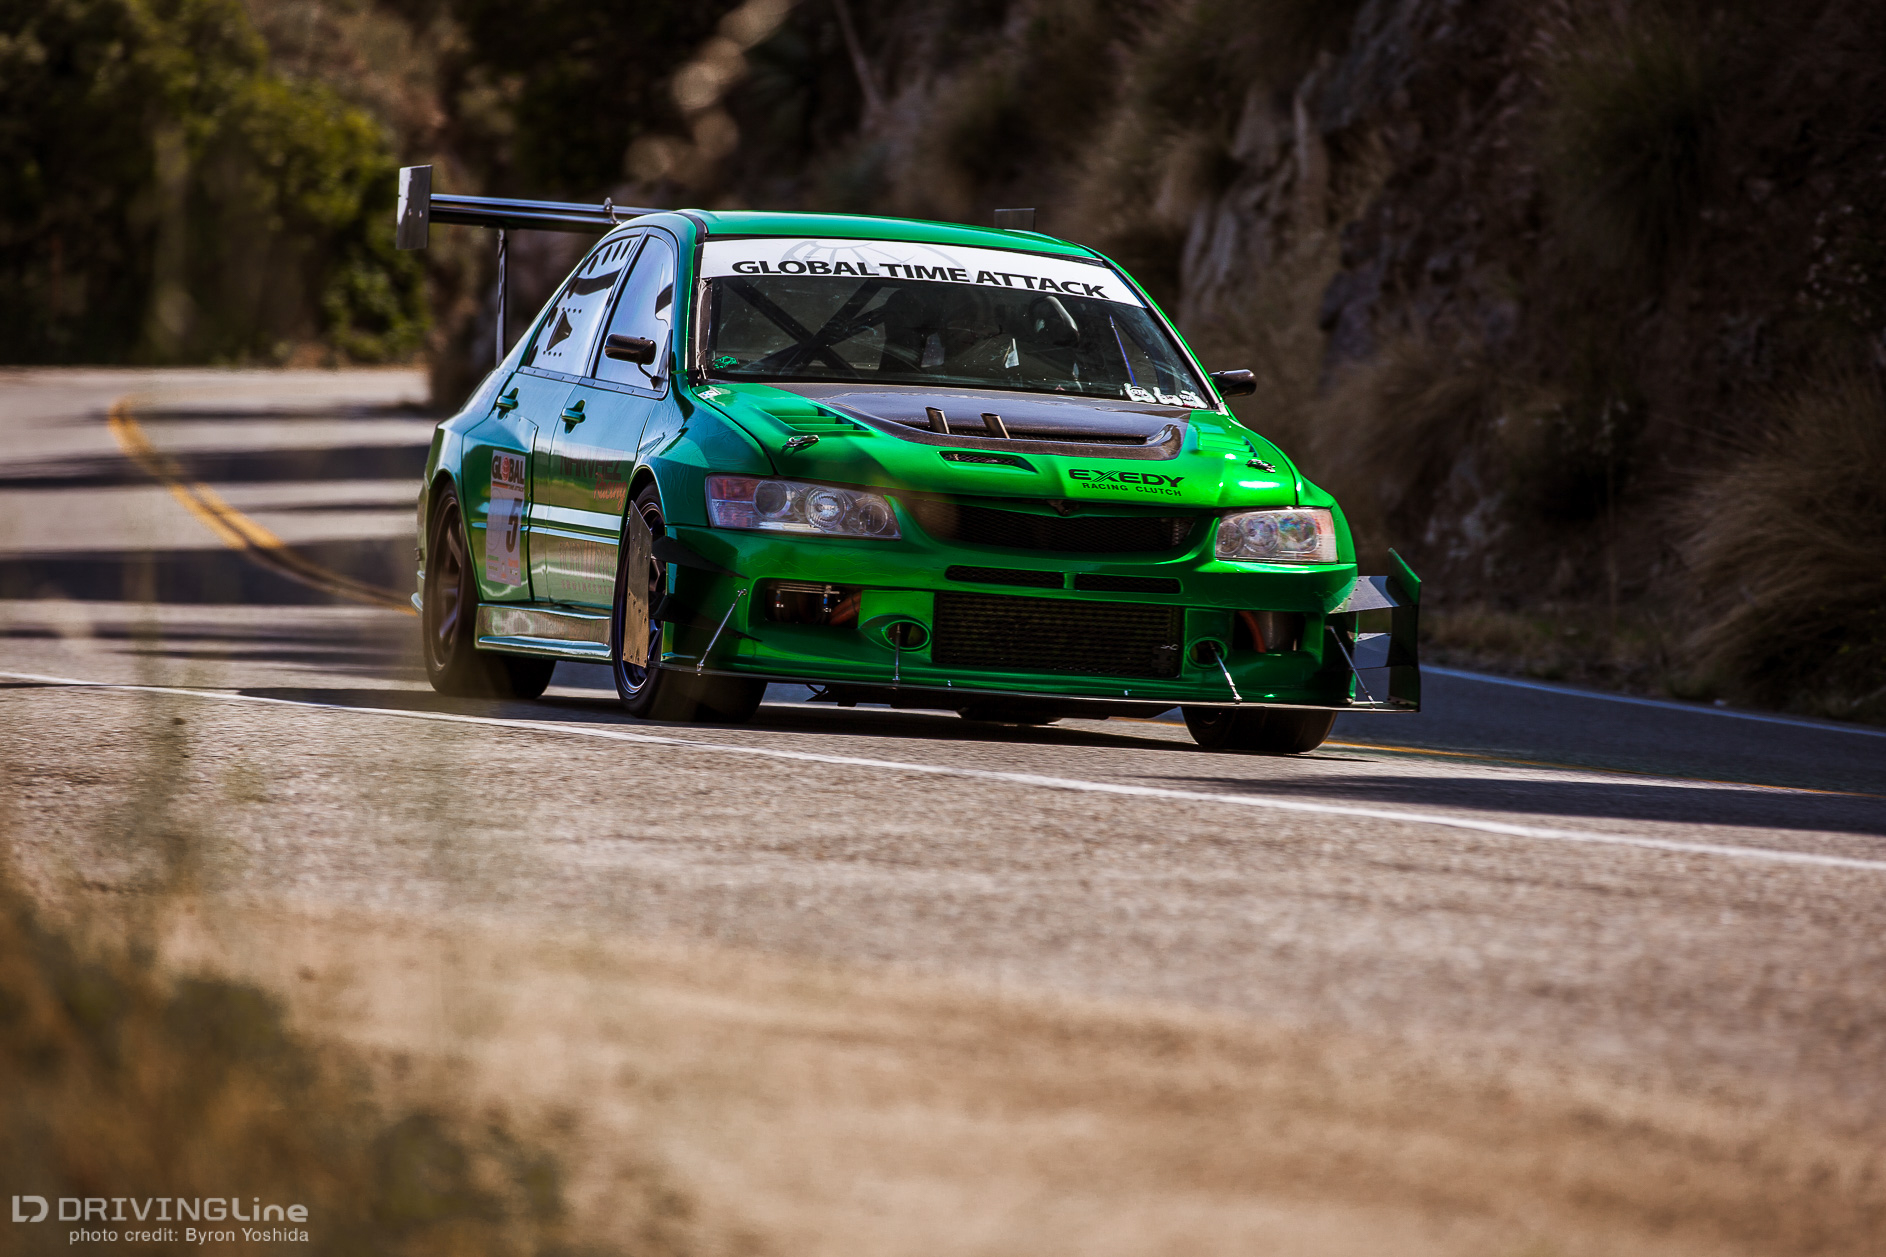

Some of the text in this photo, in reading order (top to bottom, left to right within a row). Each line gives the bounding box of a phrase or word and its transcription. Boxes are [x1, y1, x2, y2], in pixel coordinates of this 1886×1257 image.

[732, 260, 1110, 299] GLOBAL TIME ATTACK
[1069, 469, 1184, 487] EXEDY
[1082, 482, 1182, 497] RACING CLUTCH
[506, 497, 523, 553] 5
